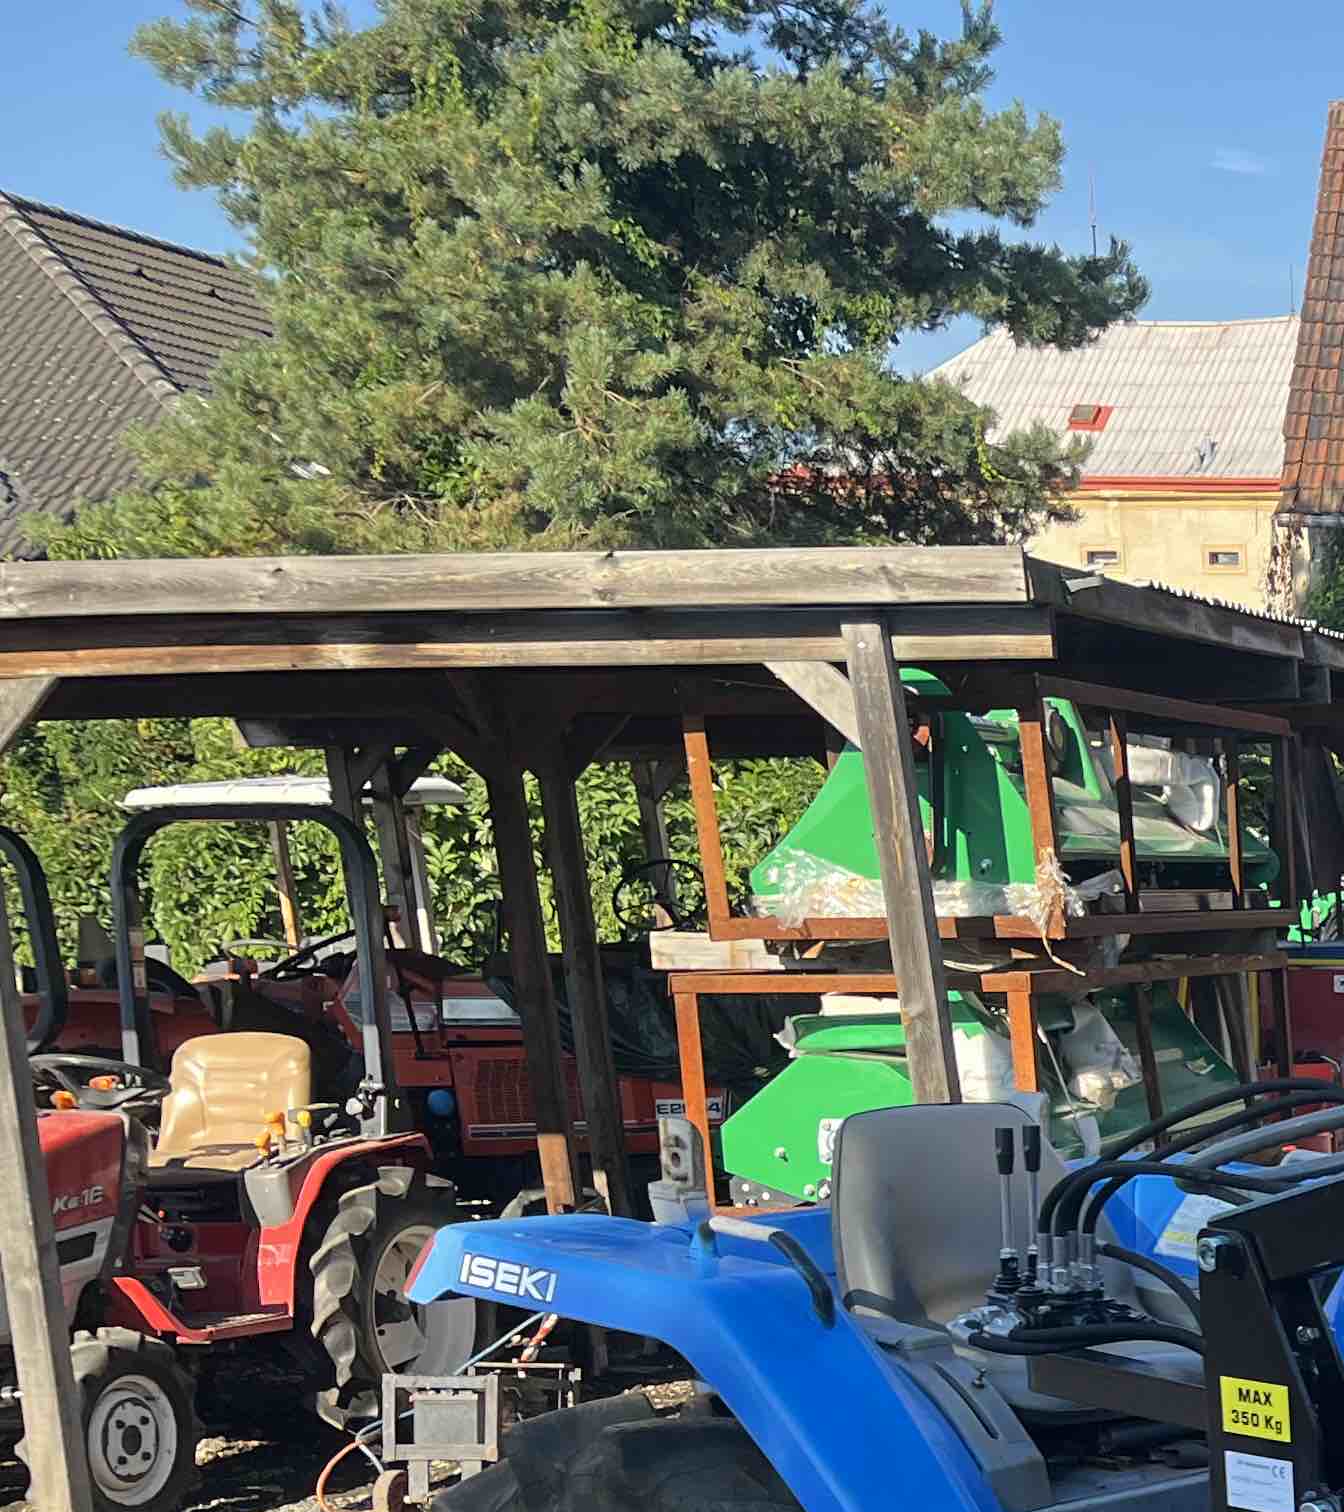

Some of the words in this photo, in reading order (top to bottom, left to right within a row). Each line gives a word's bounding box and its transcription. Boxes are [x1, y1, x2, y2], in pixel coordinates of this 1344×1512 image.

[459, 1253, 558, 1303] ISEKI
[1238, 1387, 1273, 1407] MAX
[1231, 1409, 1259, 1427] 350
[1264, 1415, 1282, 1435] Kg
